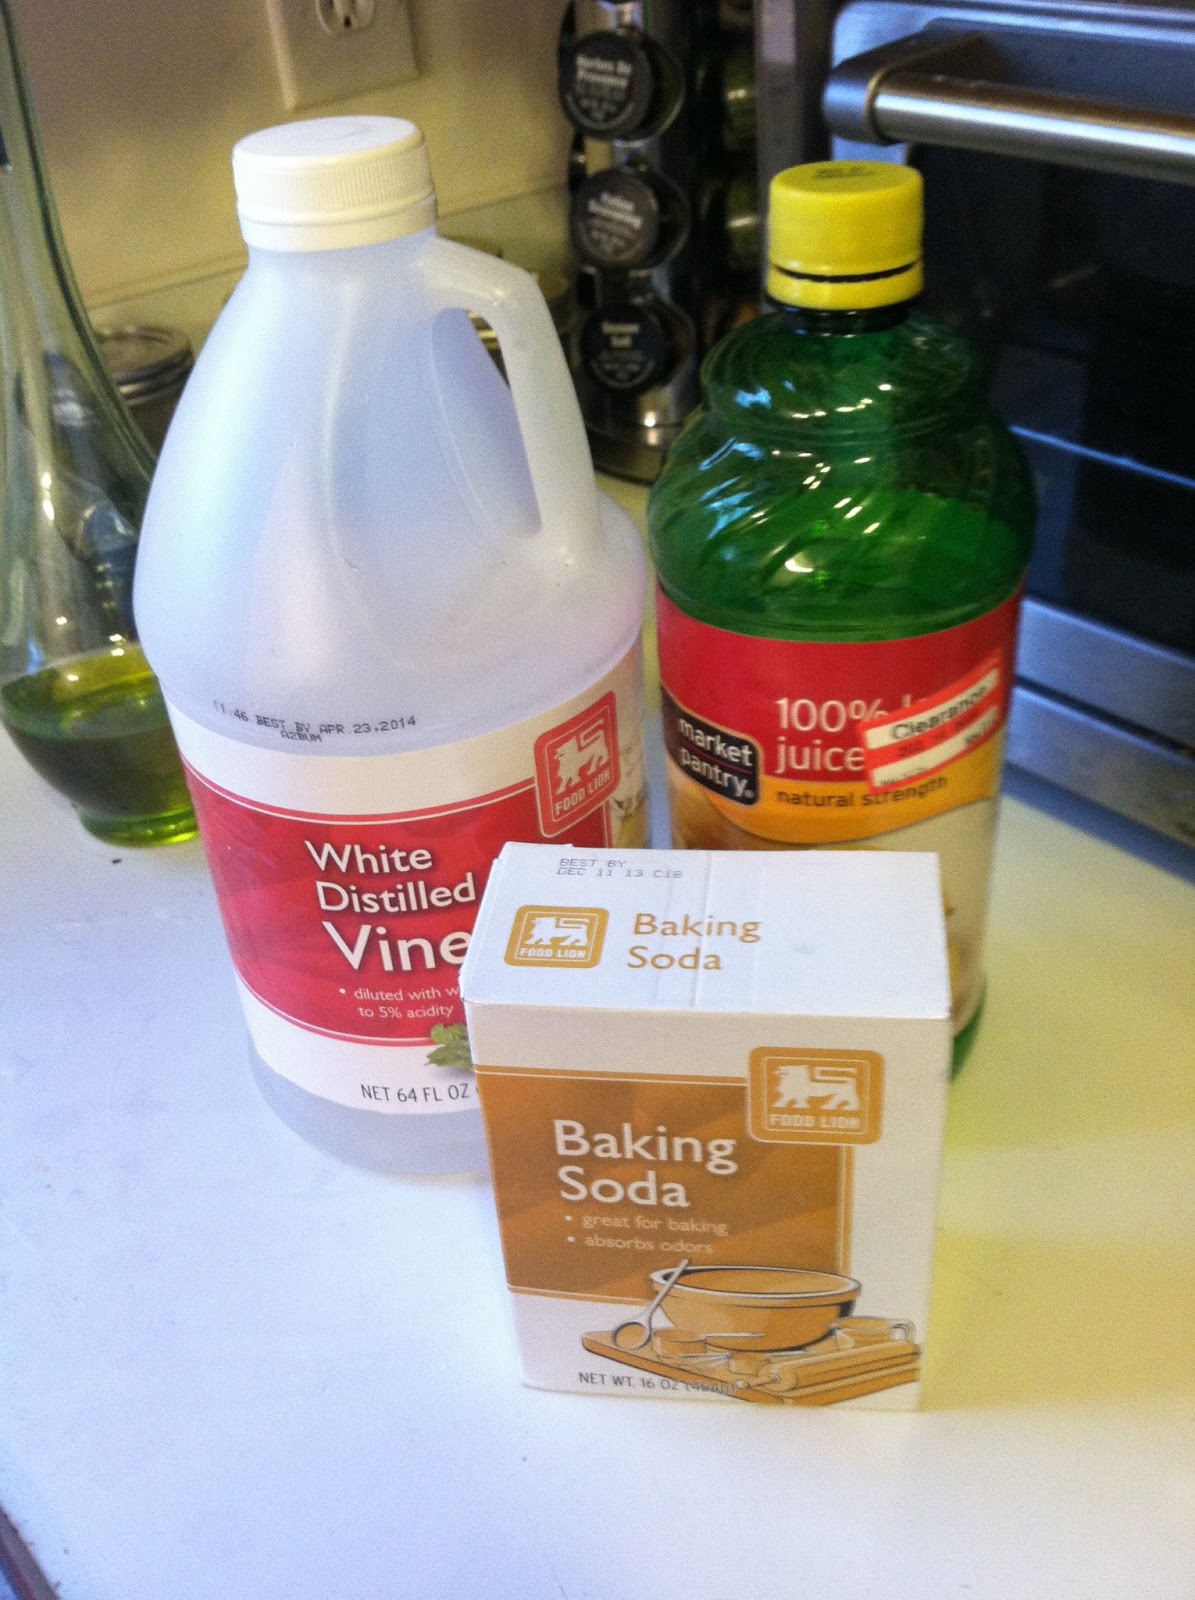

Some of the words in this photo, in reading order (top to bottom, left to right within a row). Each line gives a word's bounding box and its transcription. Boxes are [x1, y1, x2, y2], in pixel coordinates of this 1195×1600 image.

[255, 714, 286, 729] BEST
[295, 721, 311, 732] BY
[319, 724, 345, 734] APR
[774, 697, 889, 732] 100%
[679, 717, 753, 767] market
[774, 735, 865, 774] juice
[554, 787, 586, 816] FOOD
[776, 790, 855, 807] natural
[861, 776, 948, 806] strength
[304, 840, 433, 874] White
[559, 858, 598, 867] BEST
[607, 859, 628, 868] BY
[557, 867, 587, 876] DEC
[597, 868, 614, 877] 11
[316, 872, 476, 913] Distilled
[633, 912, 762, 944] Baking
[519, 947, 553, 959] FOOD
[556, 948, 586, 960] LION
[627, 946, 723, 970] Soda
[354, 987, 404, 1000] diluted
[408, 986, 442, 1000] with
[358, 1007, 374, 1018] to
[379, 1006, 402, 1019] 5%
[407, 1004, 454, 1018] acidity
[360, 1083, 390, 1101] NET
[397, 1087, 418, 1102] 64
[422, 1086, 443, 1101] FL
[448, 1082, 471, 1100] OZ
[770, 1113, 815, 1128] FOOD
[819, 1115, 861, 1129] LION
[554, 1119, 739, 1175] Baking
[558, 1165, 691, 1208] Soda
[583, 1215, 631, 1229] great
[636, 1215, 663, 1230] for
[667, 1218, 729, 1237] baking
[585, 1234, 655, 1250] absorbs
[660, 1239, 714, 1253] odors
[578, 1372, 607, 1385] NET
[640, 1377, 656, 1389] 16
[660, 1379, 682, 1390] OZ
